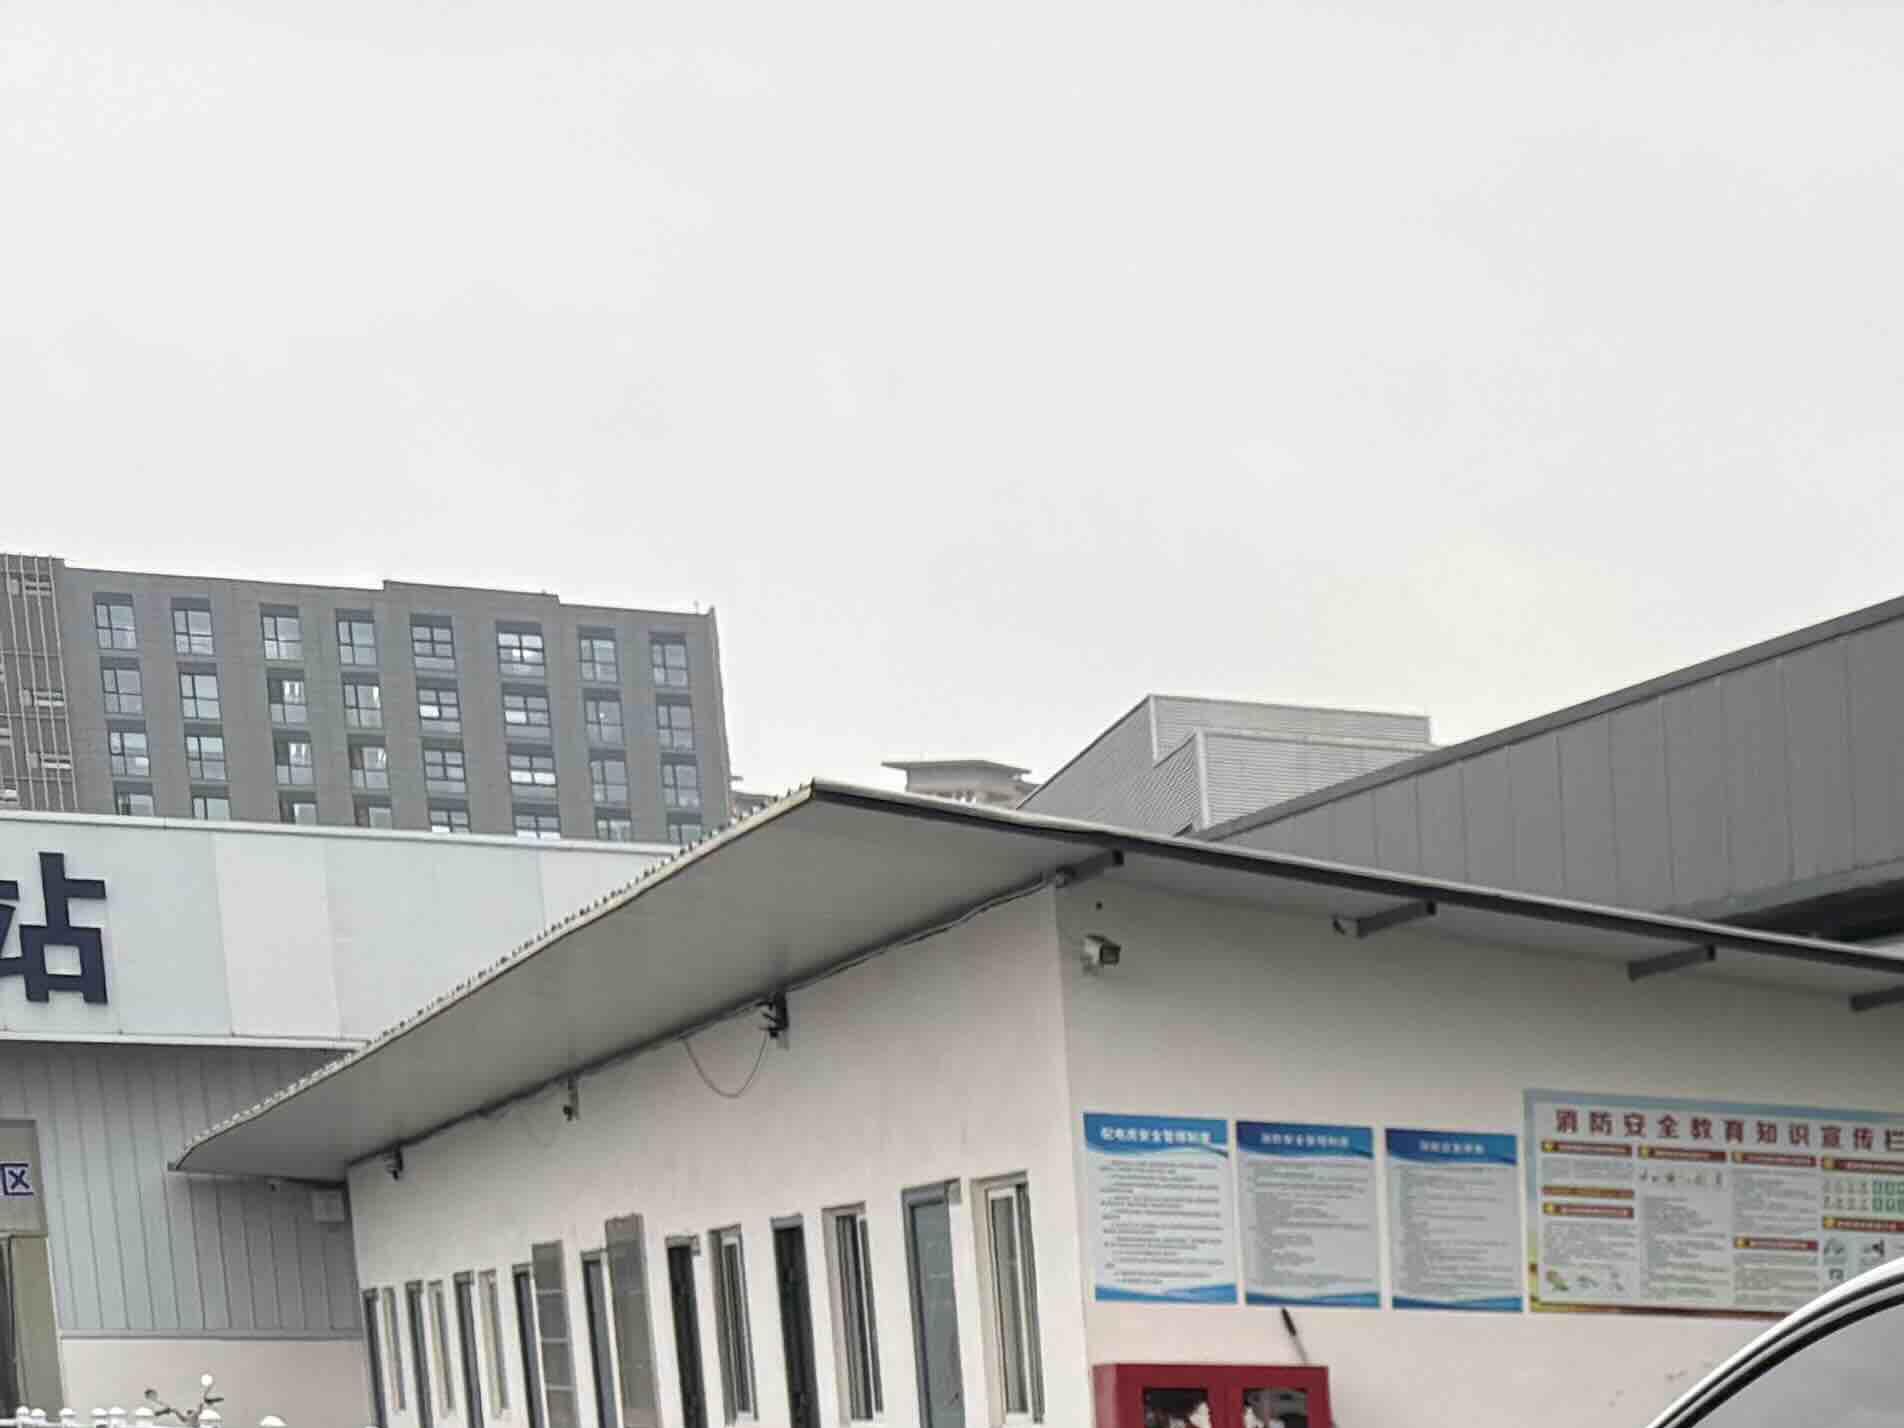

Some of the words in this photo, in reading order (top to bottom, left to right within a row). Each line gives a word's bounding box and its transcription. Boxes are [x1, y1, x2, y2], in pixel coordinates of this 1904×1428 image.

[0, 852, 108, 1005] 站
[1555, 1108, 1904, 1152] 消防安全教育知识宣传栏
